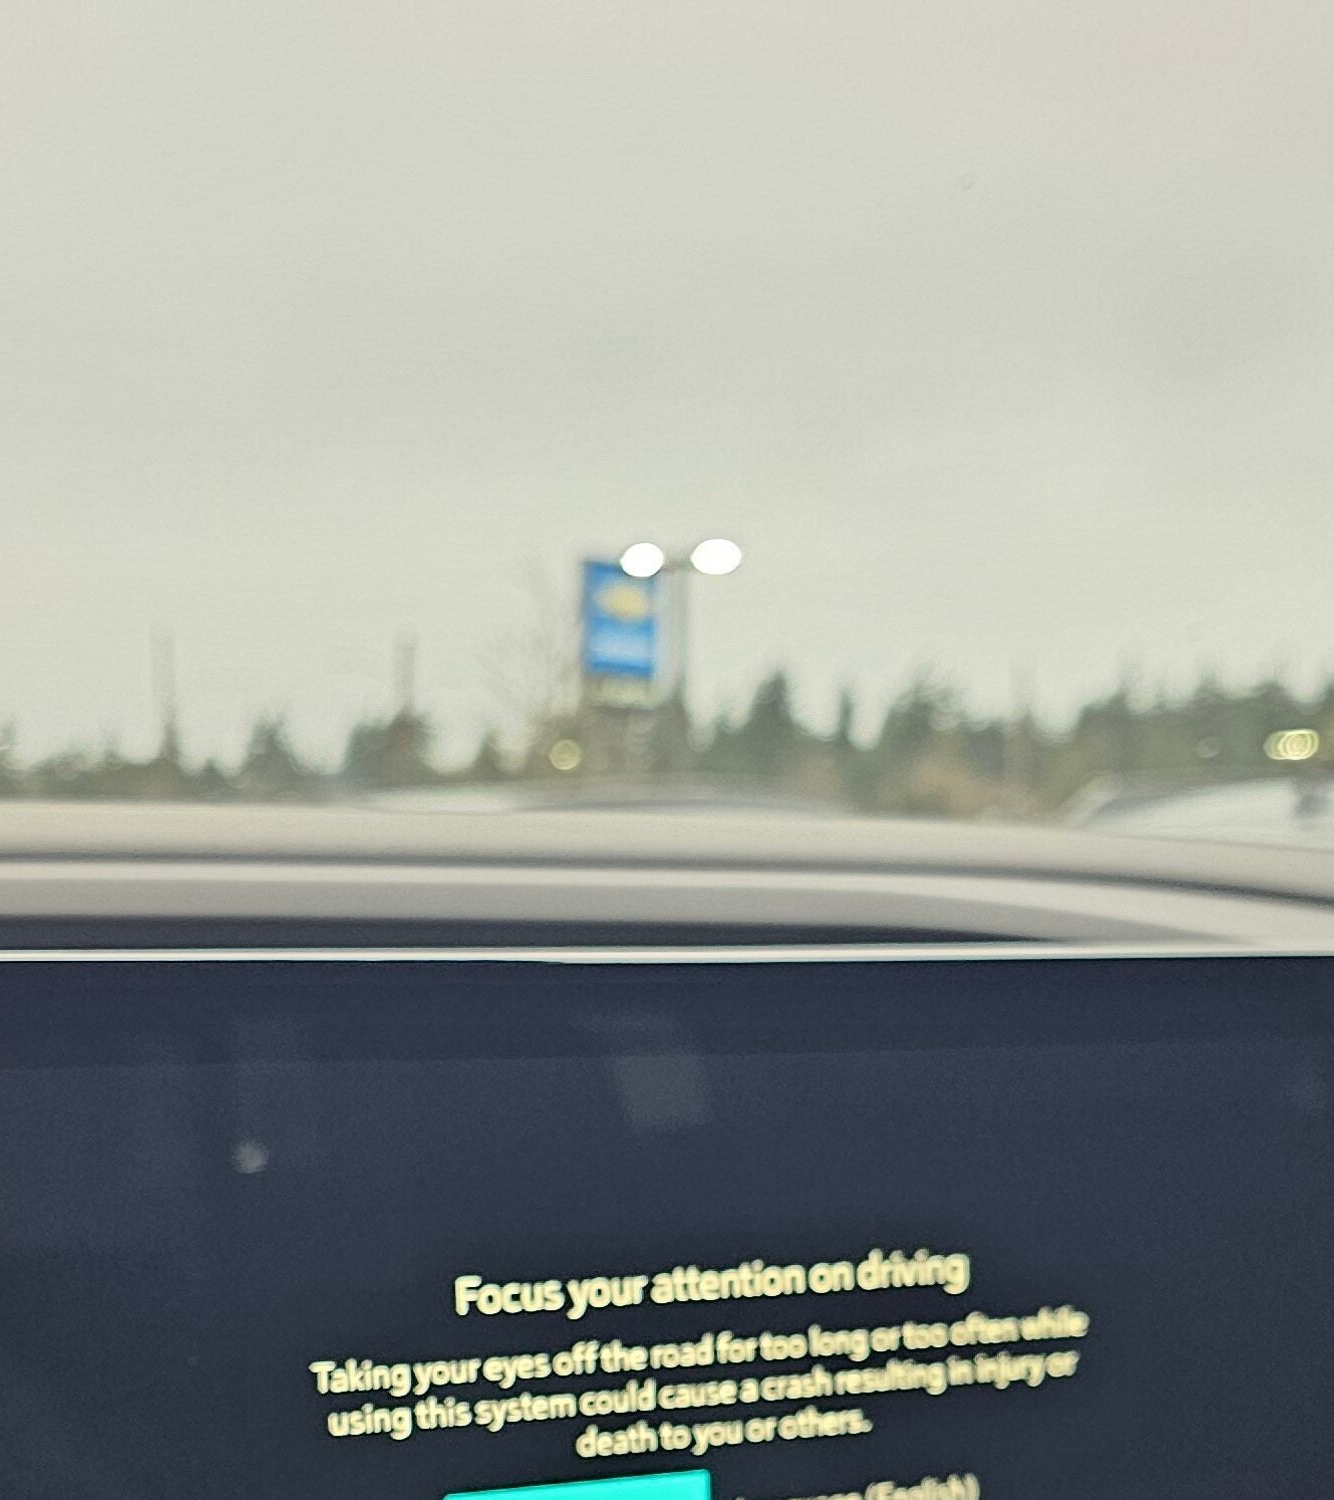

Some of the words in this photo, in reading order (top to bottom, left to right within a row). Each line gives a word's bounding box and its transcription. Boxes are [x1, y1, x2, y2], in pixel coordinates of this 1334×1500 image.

[455, 1275, 566, 1315] Focus
[566, 1275, 648, 1320] your
[651, 1258, 807, 1304] attention
[808, 1261, 854, 1294] on
[856, 1248, 971, 1295] driving
[308, 1358, 411, 1397] Taking
[413, 1358, 482, 1395] your
[483, 1353, 551, 1389] eyes
[553, 1340, 599, 1376] off
[599, 1339, 648, 1373] the
[649, 1331, 715, 1369] road
[716, 1329, 759, 1364] for
[759, 1331, 808, 1361] too
[808, 1324, 870, 1362] long
[870, 1326, 901, 1352] or
[902, 1321, 949, 1350] too
[949, 1311, 1020, 1346] often
[1020, 1304, 1090, 1341] while
[327, 1403, 413, 1440] using
[415, 1395, 473, 1430] this
[474, 1392, 577, 1432] system
[579, 1377, 657, 1417] could
[658, 1379, 738, 1410] cause
[739, 1377, 759, 1404] a
[760, 1364, 834, 1402] crash
[834, 1357, 947, 1396] resulting
[946, 1355, 975, 1386] in
[975, 1351, 1045, 1389] injury
[1045, 1350, 1080, 1378] or
[575, 1419, 659, 1459] death
[659, 1421, 691, 1451] to
[690, 1420, 744, 1456] you
[745, 1416, 779, 1443] or
[778, 1405, 873, 1441] others.
